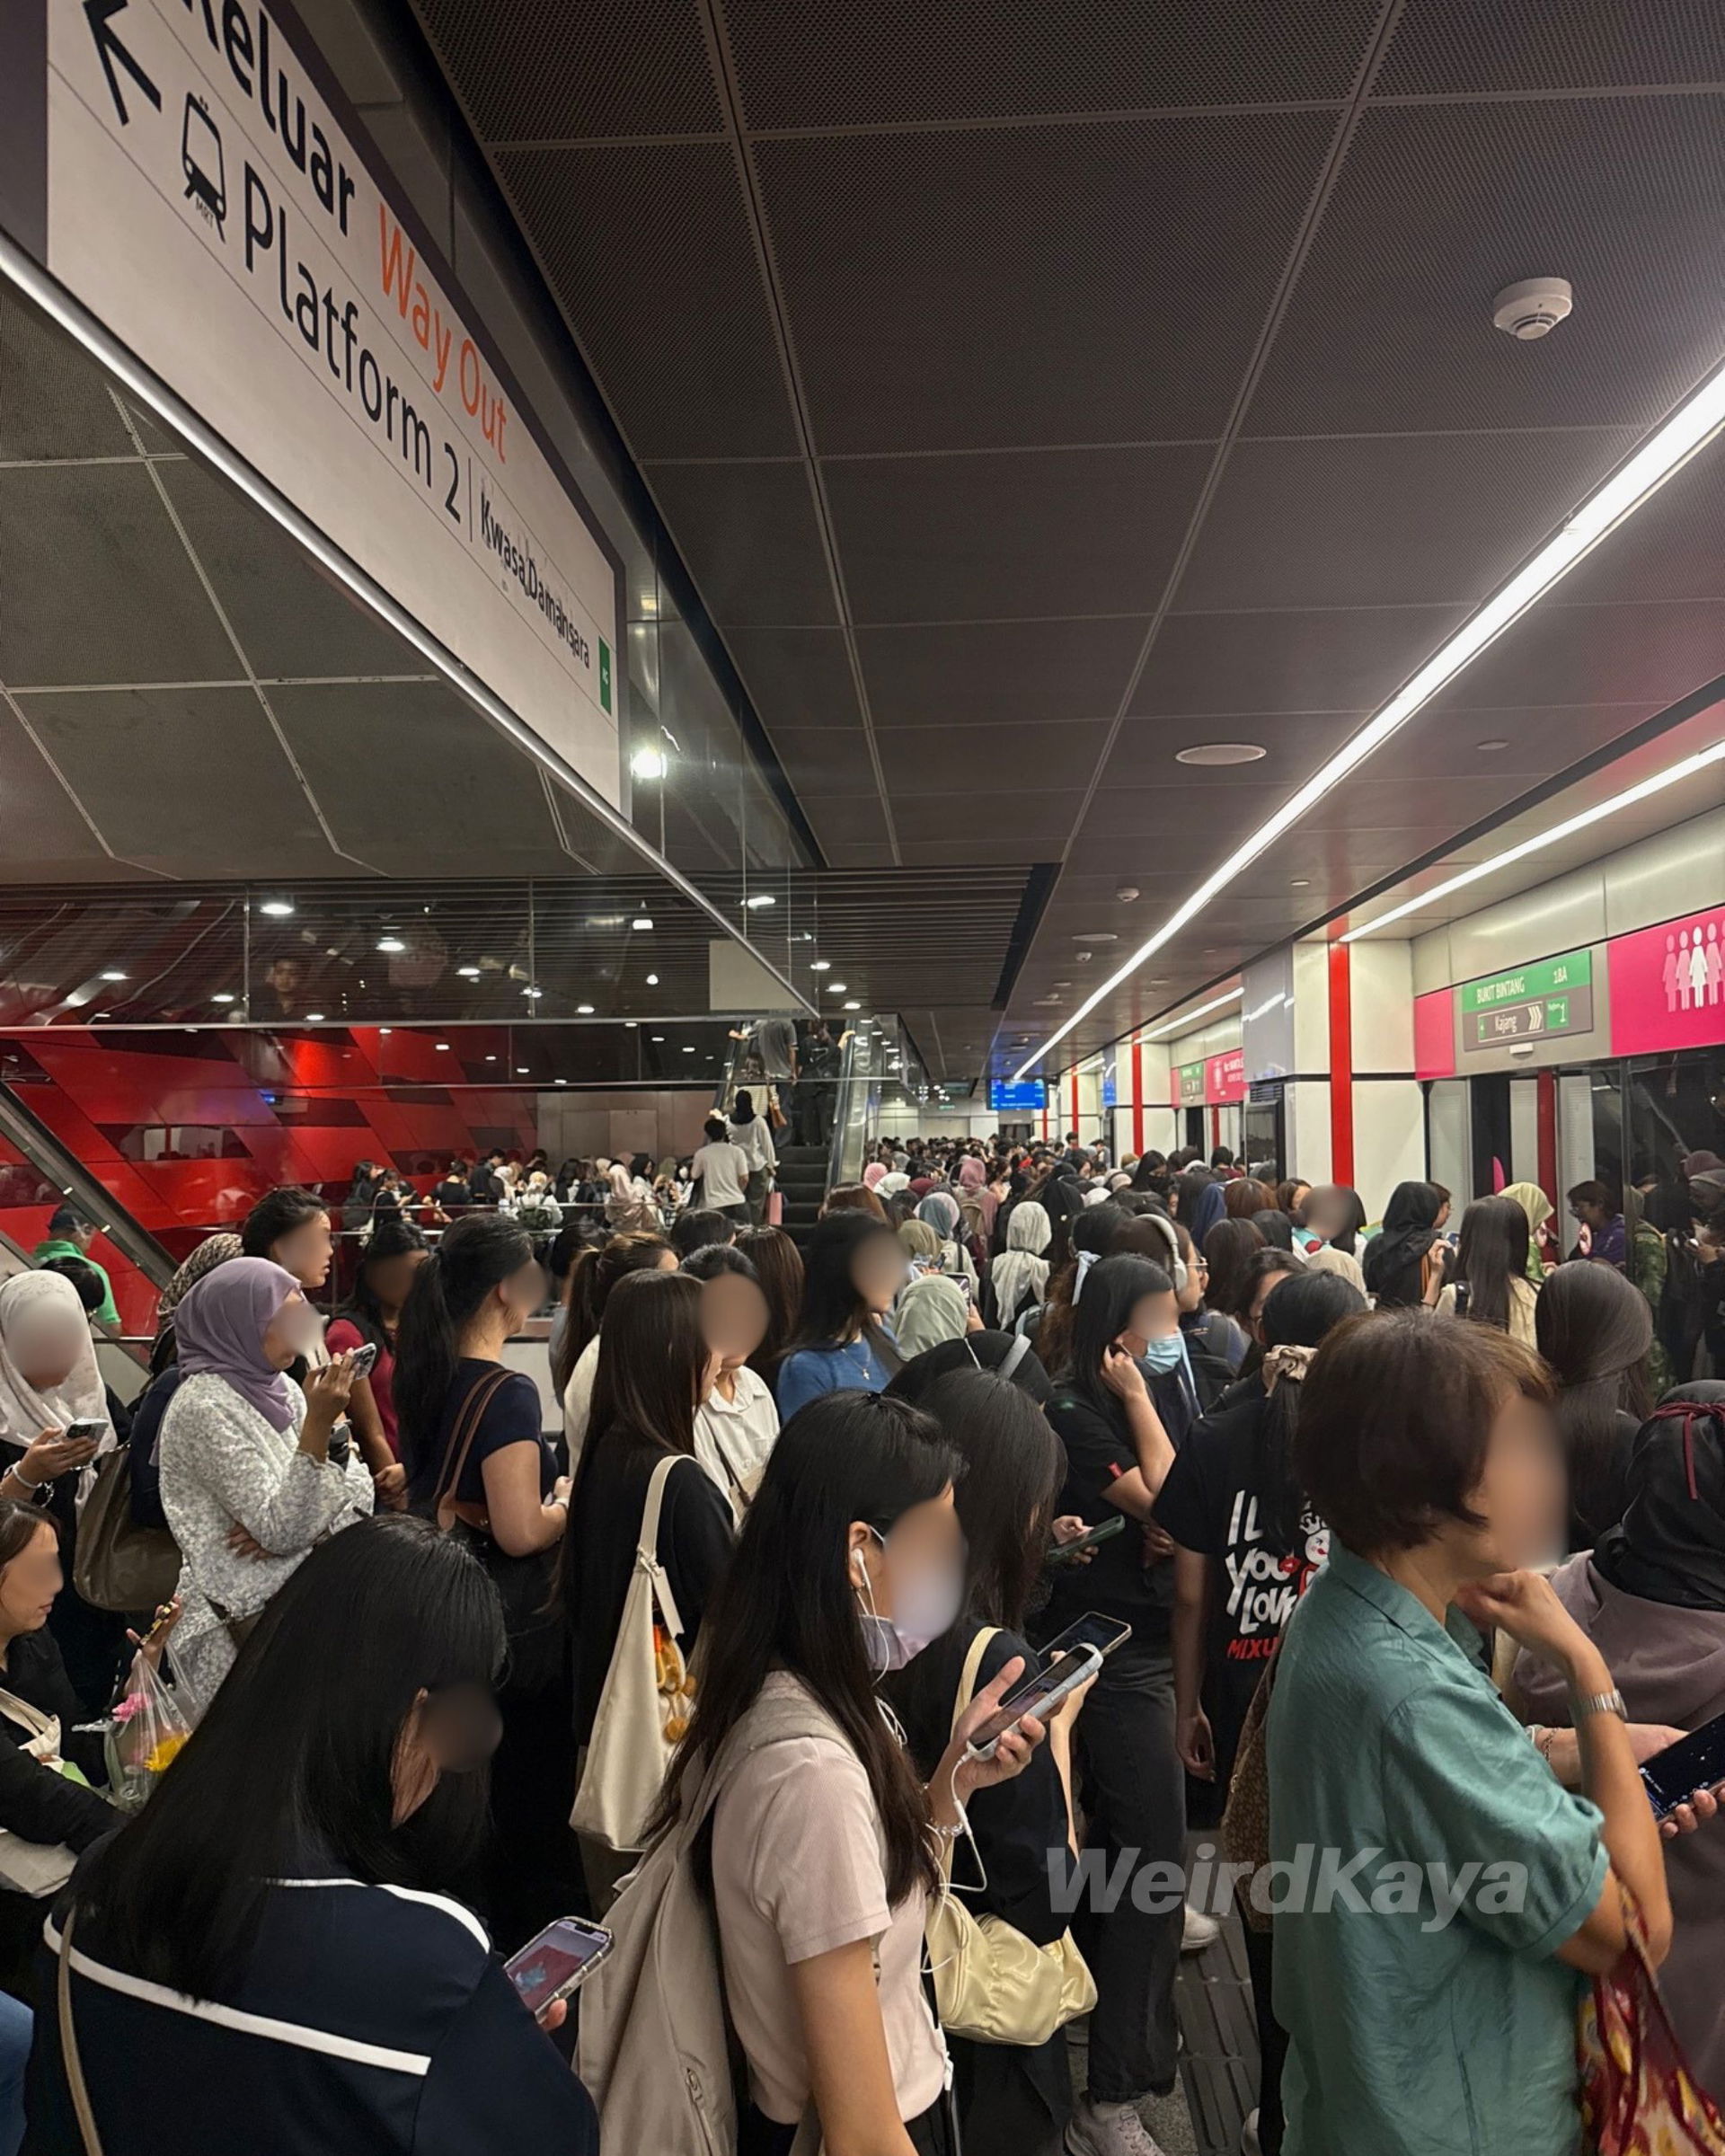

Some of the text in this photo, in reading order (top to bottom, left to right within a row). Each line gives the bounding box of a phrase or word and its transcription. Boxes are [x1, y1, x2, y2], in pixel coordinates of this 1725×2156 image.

[379, 202, 452, 393] Way
[459, 338, 507, 464] Out
[244, 160, 590, 669] Platform 2 Kwasa Damansara
[1495, 976, 1526, 1000] BINTANG
[1495, 1014, 1517, 1034] Kajang
[1226, 1637, 1279, 1659] MIXU
